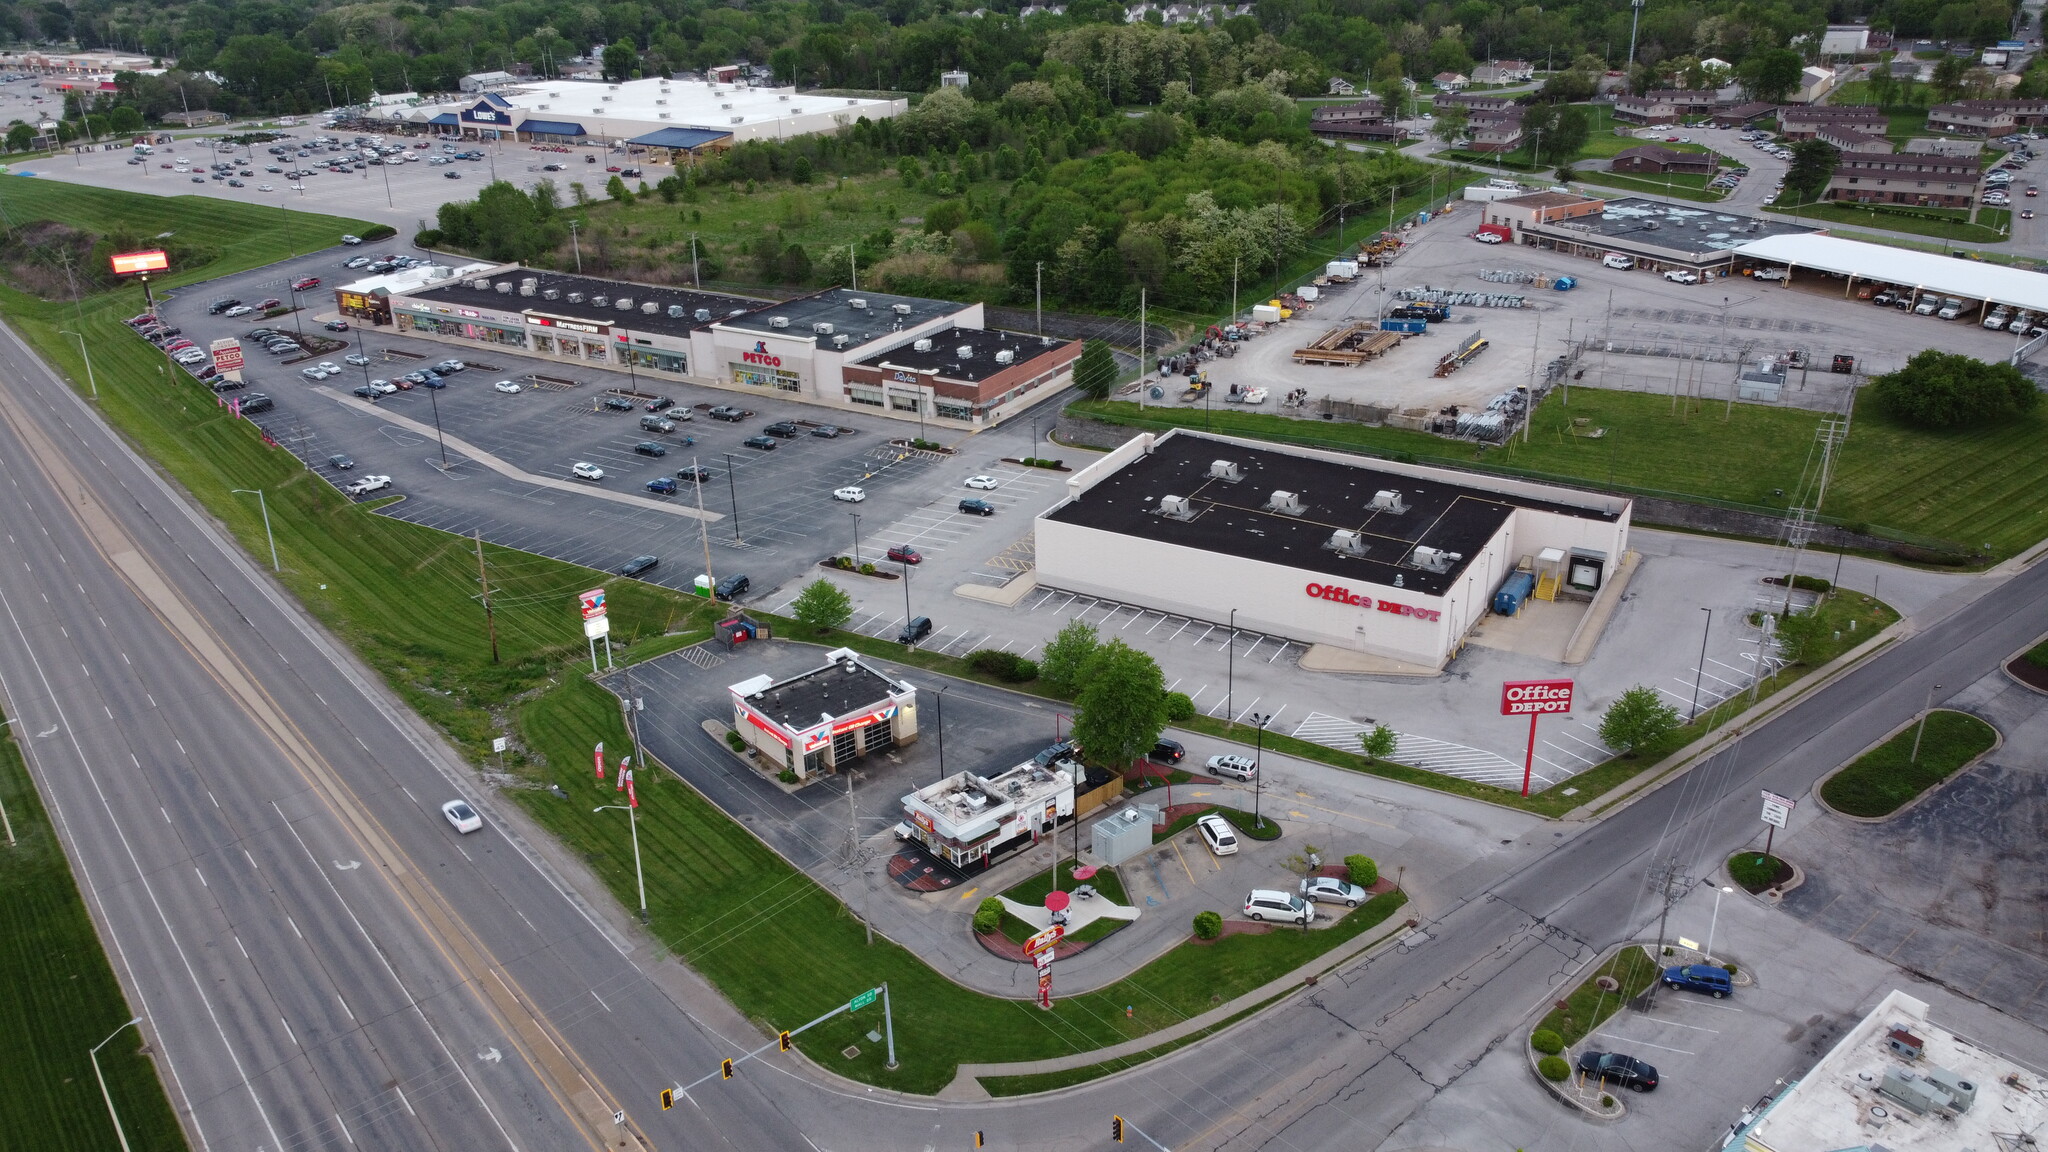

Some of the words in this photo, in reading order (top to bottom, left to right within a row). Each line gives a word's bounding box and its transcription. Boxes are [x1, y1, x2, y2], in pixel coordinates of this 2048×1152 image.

[216, 353, 240, 361] PETCO
[743, 352, 781, 367] PETCO
[1306, 583, 1372, 608] Office
[1377, 600, 1441, 622] DEPOT
[1507, 686, 1570, 701] Office
[1510, 701, 1569, 713] DEPOT
